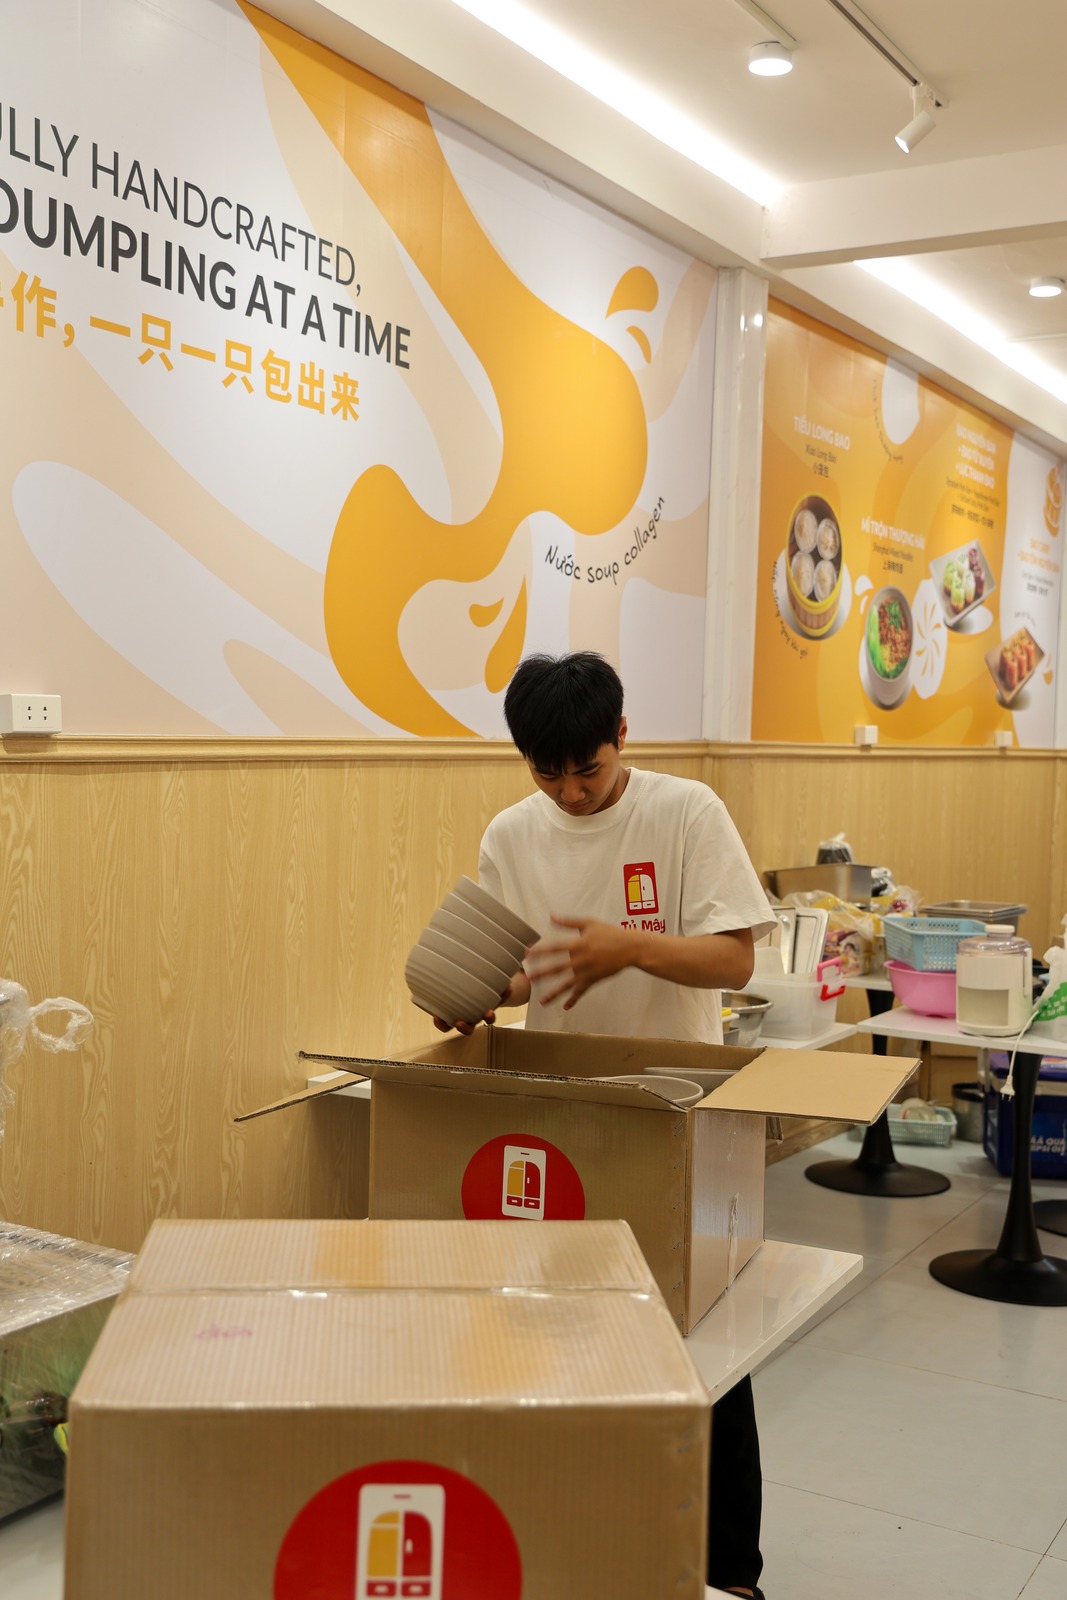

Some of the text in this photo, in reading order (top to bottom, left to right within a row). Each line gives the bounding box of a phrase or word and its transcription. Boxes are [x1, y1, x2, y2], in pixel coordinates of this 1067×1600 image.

[0, 102, 362, 297] LLY HANDCRAFTED,
[245, 274, 296, 330] AT
[301, 294, 326, 343] A
[332, 301, 412, 370] TIME
[545, 496, 665, 586] Nước soup collagen
[641, 918, 666, 933] Mây
